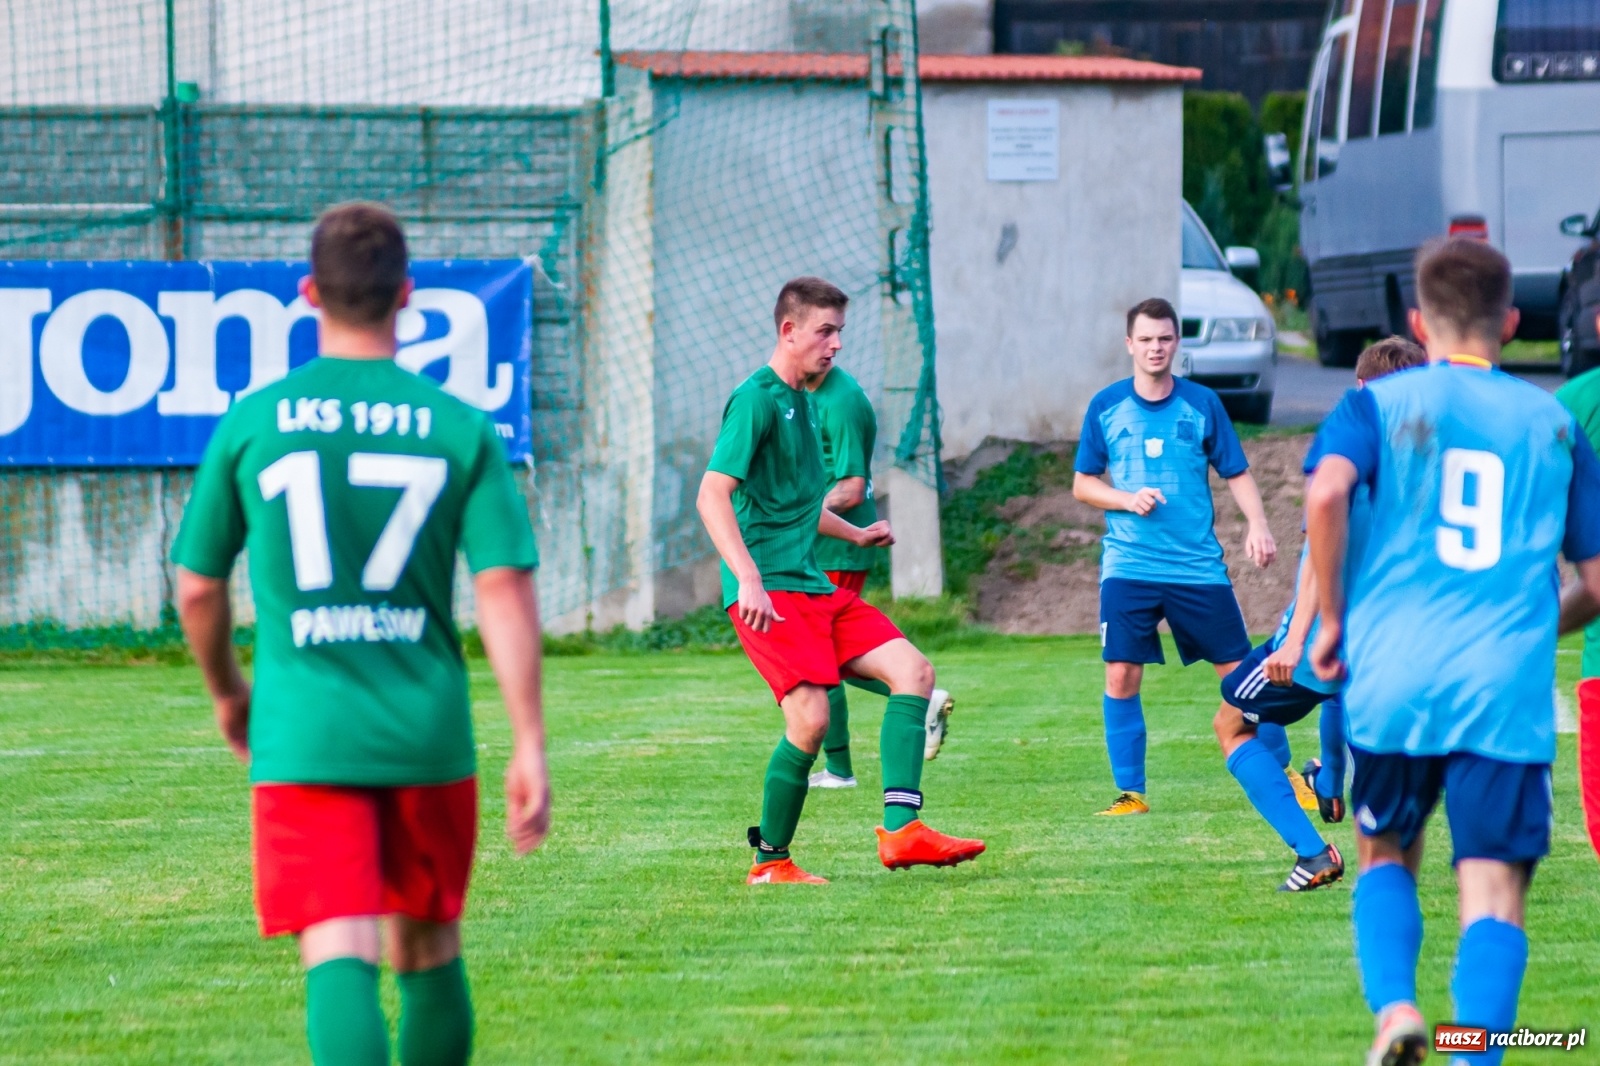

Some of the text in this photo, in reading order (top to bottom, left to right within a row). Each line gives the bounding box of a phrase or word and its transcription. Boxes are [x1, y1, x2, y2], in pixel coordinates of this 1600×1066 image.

[276, 397, 432, 439] LKS 1911
[257, 450, 448, 592] 17
[1436, 447, 1505, 572] 9
